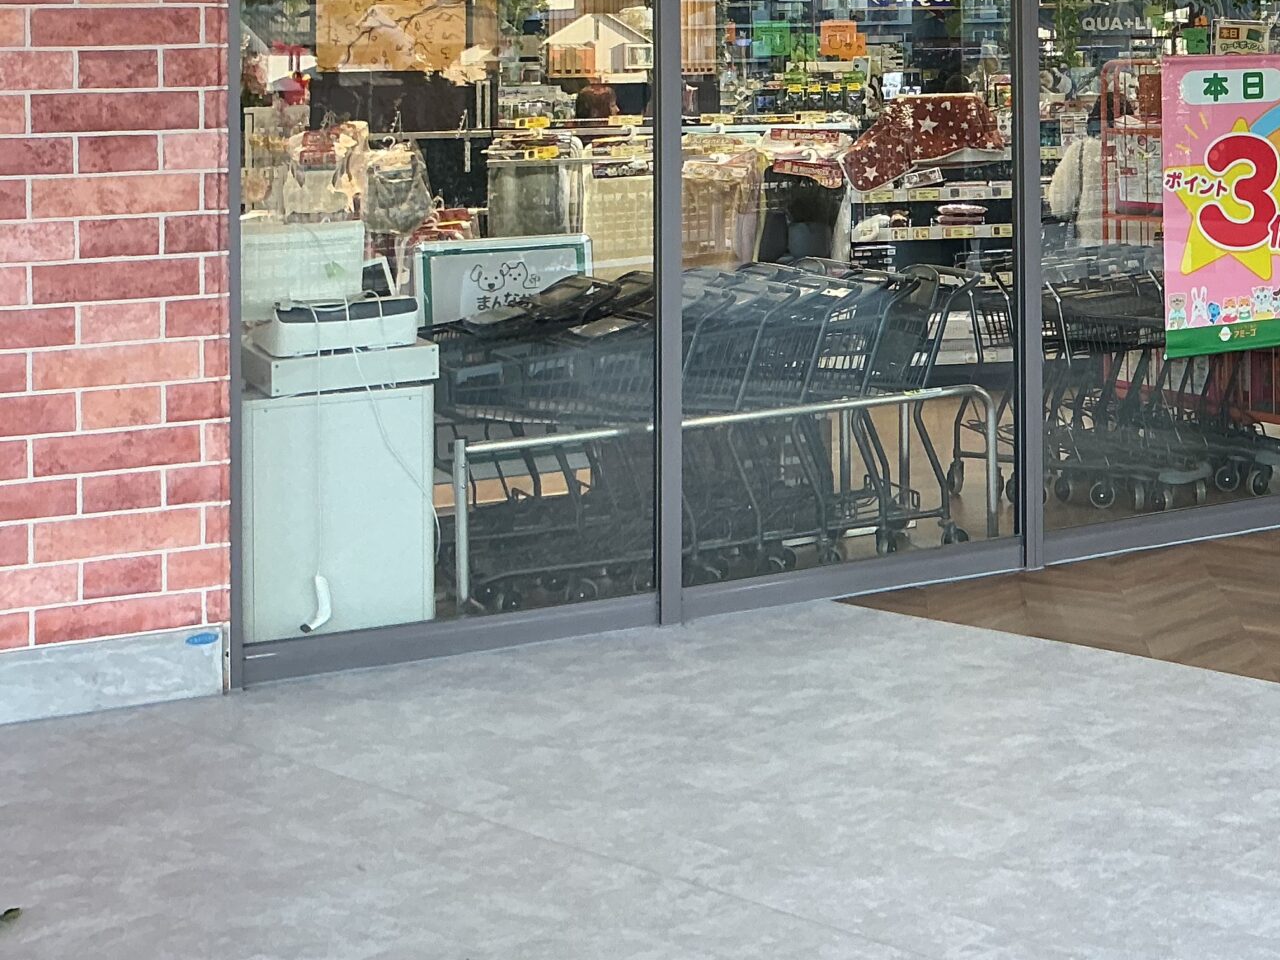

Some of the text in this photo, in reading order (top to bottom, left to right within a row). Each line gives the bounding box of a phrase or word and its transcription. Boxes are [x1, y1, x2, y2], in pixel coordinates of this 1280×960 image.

[1077, 16, 1152, 32] QUA+LI
[1221, 29, 1238, 38] 本日
[1220, 41, 1265, 52] カードポイント
[1203, 71, 1264, 102] 本日
[1164, 172, 1228, 197] ポイント
[1200, 135, 1277, 248] 3
